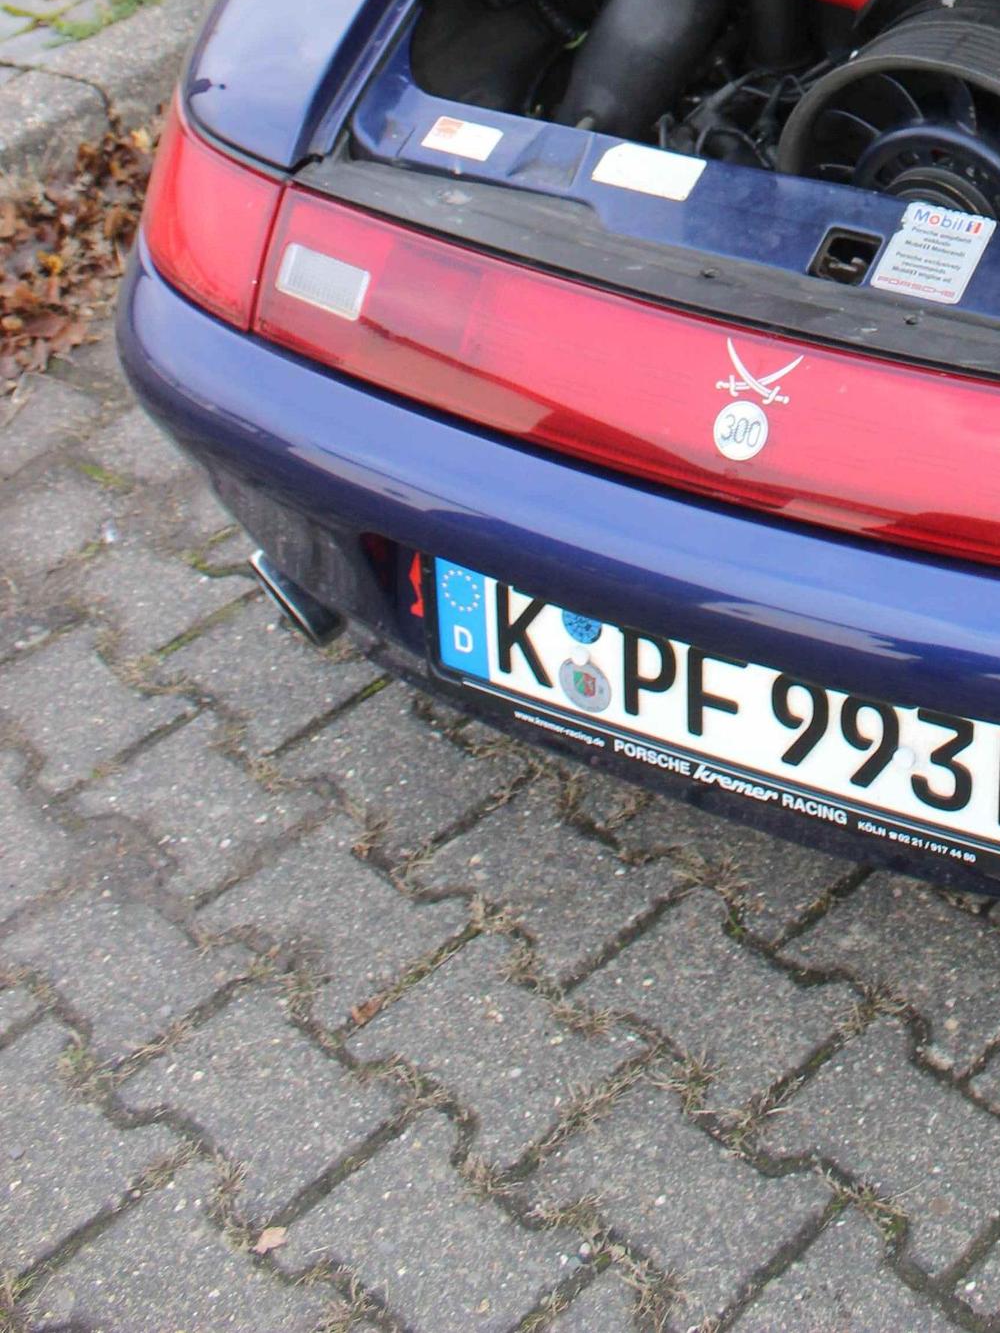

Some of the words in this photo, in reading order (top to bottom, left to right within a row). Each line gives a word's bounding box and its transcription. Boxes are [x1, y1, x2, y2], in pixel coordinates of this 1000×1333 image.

[914, 209, 964, 231] Mobil
[877, 275, 956, 297] PORSCHE
[721, 414, 761, 448] 300
[453, 625, 473, 653] D
[496, 581, 553, 688] K
[620, 626, 748, 737] PF
[513, 710, 606, 748] www.kremer-racing.de
[614, 738, 691, 776] PORSCHE
[693, 765, 779, 802] kremer
[782, 792, 848, 825] RACING
[857, 820, 887, 838] KÖLN
